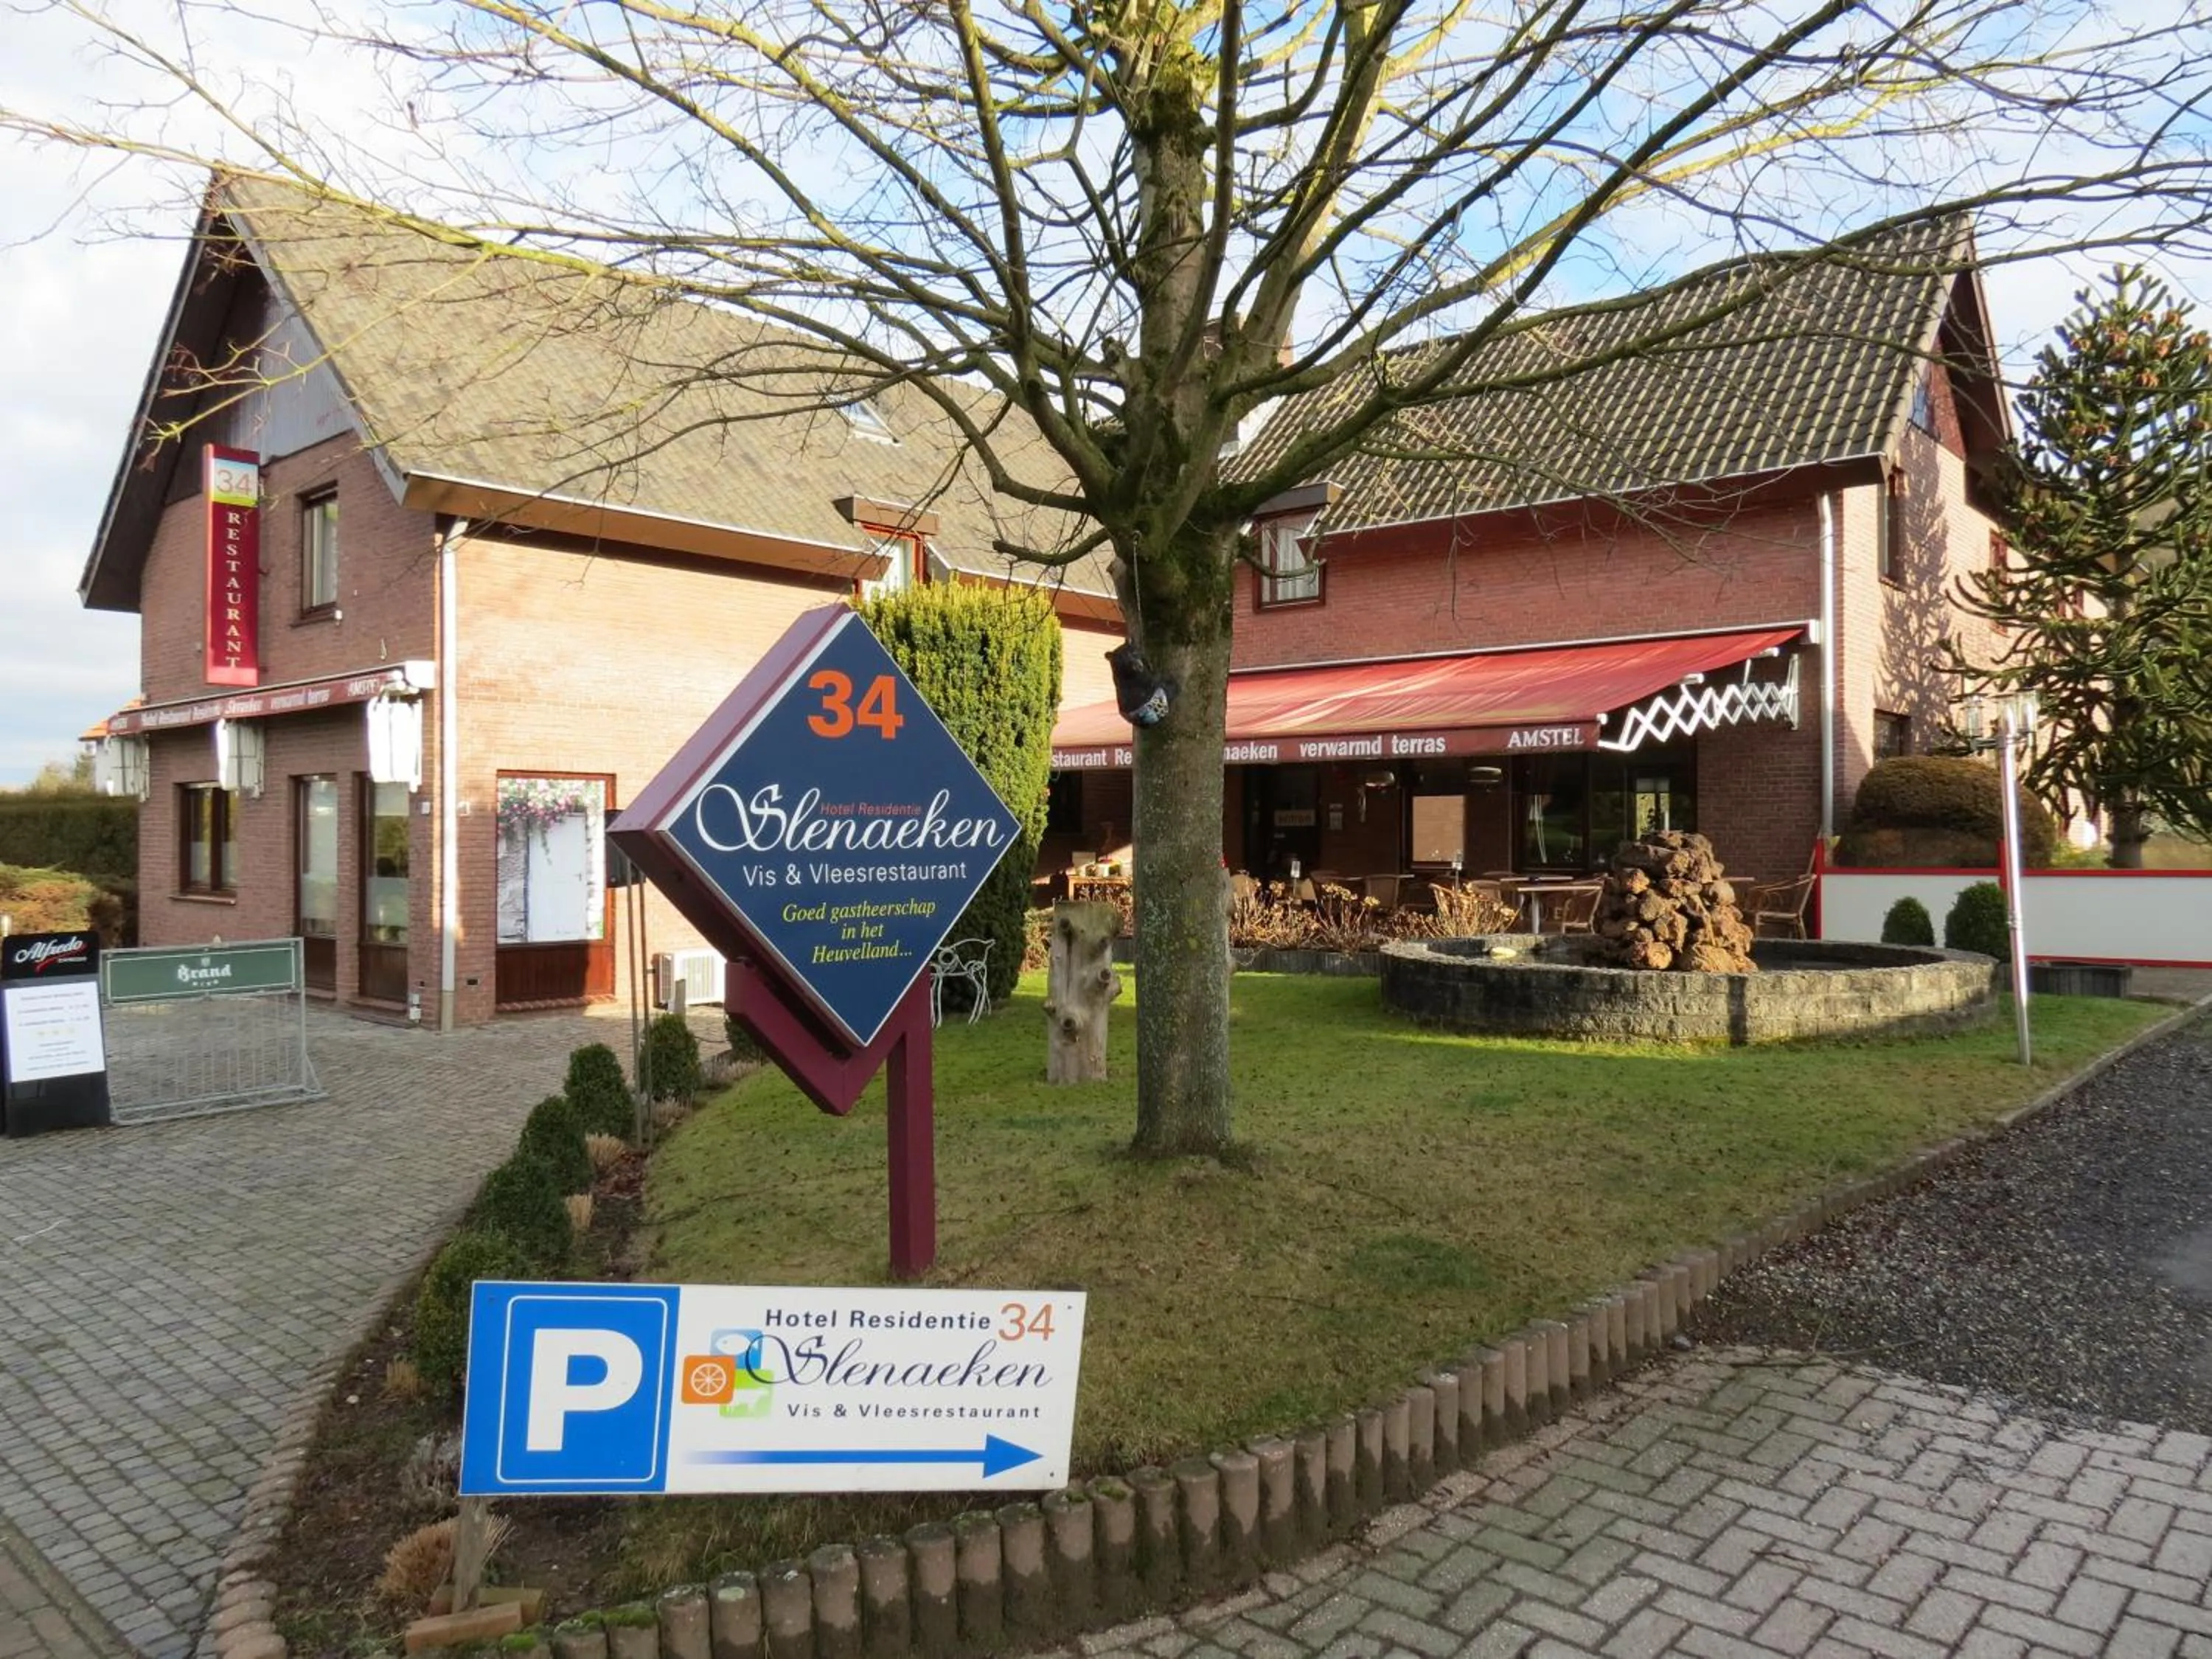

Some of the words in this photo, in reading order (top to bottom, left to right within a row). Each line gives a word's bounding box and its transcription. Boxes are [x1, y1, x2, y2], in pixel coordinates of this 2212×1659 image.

[217, 469, 252, 498] 34
[225, 511, 242, 668] RESTAURANT
[807, 669, 904, 740] 34
[1051, 748, 1107, 768] staurant
[1299, 736, 1382, 758] verwarmd
[1391, 735, 1446, 754] terras
[1508, 728, 1585, 748] AMSTEL
[695, 783, 1006, 852] Slenaeken
[821, 802, 855, 815] Hotel
[858, 801, 921, 815] Residentie
[742, 866, 776, 886] Vis
[785, 863, 801, 885] &
[810, 861, 967, 884] Vleesrestaurant
[782, 902, 827, 922] Goed
[830, 897, 936, 924] gastheerschap
[841, 924, 856, 940] in
[860, 922, 884, 939] het
[15, 936, 83, 963] Alfredo
[178, 964, 232, 982] Brand
[765, 1309, 837, 1327] Hotel
[849, 1310, 991, 1330] Residentie
[998, 1303, 1055, 1342] 34
[745, 1334, 1054, 1388] Slenaeken
[526, 1329, 643, 1453] P
[787, 1403, 821, 1418] Vis
[833, 1404, 847, 1417] &
[859, 1403, 1041, 1419] Vleesrestaurant
